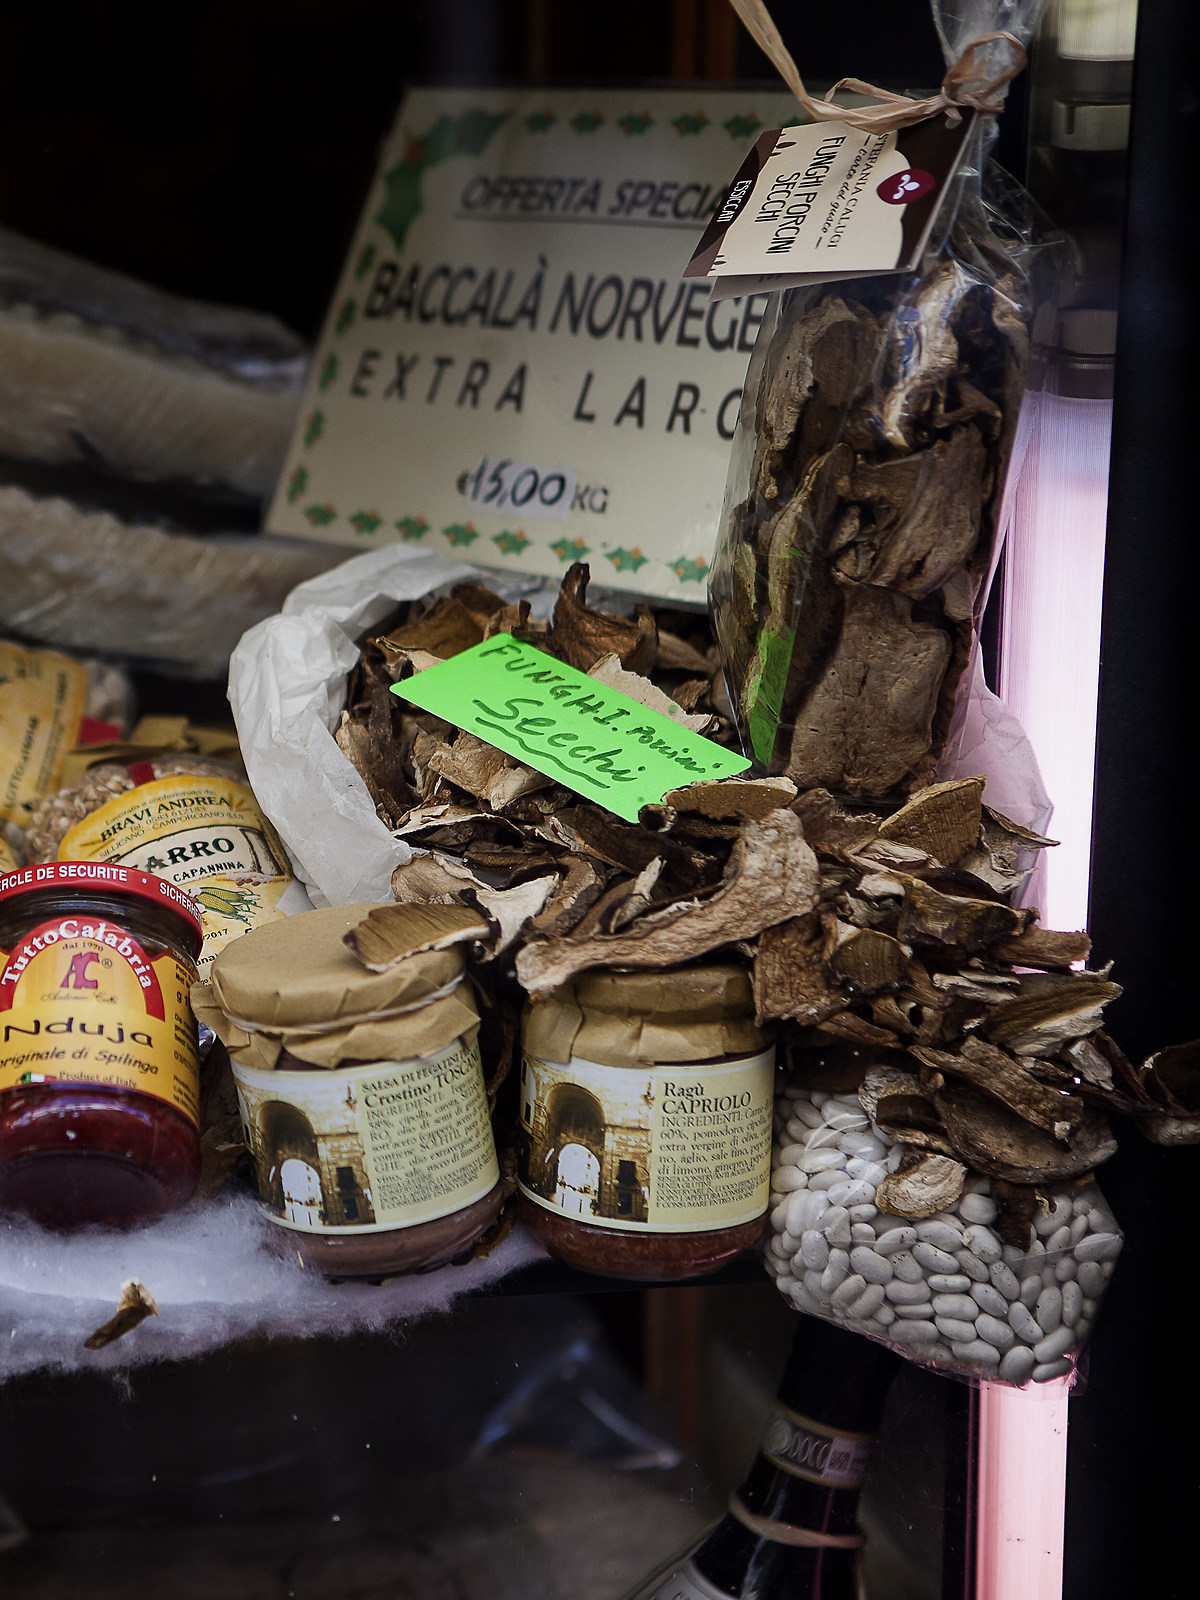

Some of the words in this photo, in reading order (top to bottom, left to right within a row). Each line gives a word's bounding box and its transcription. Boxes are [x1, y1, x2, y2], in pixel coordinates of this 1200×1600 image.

[798, 136, 847, 189] FUNGHI
[851, 133, 889, 196] STEFANIA
[461, 176, 603, 216] OFFERTA
[717, 179, 752, 223] ESSICCATI
[755, 171, 801, 223] SECCHI
[765, 190, 818, 255] PORCINI
[827, 198, 858, 248] CALUGI
[362, 254, 547, 334] BACCALÀ
[349, 349, 528, 413] EXTRA
[571, 483, 610, 515] KG
[471, 697, 647, 782] Secchi
[99, 808, 153, 843] BRAVI
[157, 795, 232, 817] ANDREA
[36, 866, 56, 882] DE
[58, 864, 129, 882] SECURITE
[132, 836, 236, 875] ARRO
[172, 860, 246, 883] CAPANNINA
[0, 919, 154, 990] TuttoCalabria
[61, 941, 79, 951] dal
[82, 941, 105, 953] 1970
[3, 1016, 155, 1050] Nduja
[58, 1071, 101, 1083] Product
[70, 1046, 89, 1060] di
[97, 1049, 160, 1076] Spilinga
[361, 1077, 400, 1094] SALSA
[364, 1081, 432, 1109] Crostino
[661, 1091, 752, 1115] CAPRIOLO
[663, 1081, 705, 1101] Ragù
[659, 1142, 686, 1152] extra
[690, 1139, 727, 1153] vergine
